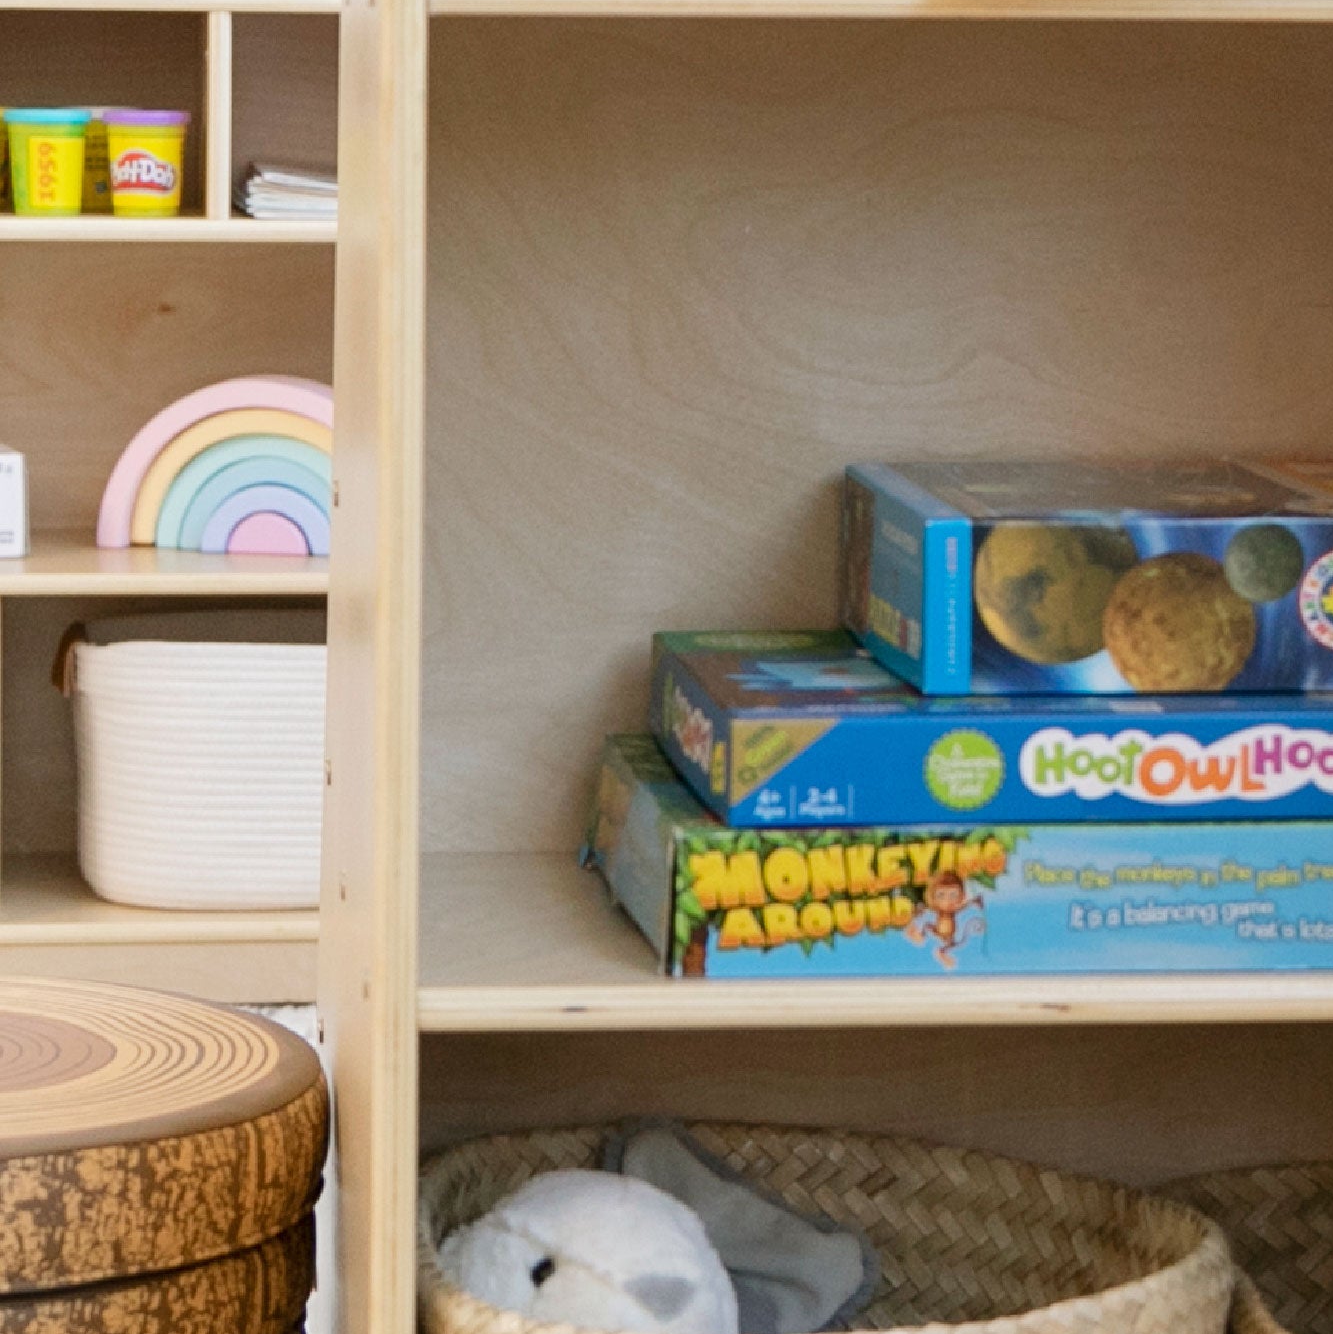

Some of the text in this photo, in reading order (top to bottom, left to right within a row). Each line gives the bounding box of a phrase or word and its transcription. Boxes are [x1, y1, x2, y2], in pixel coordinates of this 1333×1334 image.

[690, 837, 1006, 910] MONKEYING
[716, 896, 915, 951] AROUND
[1105, 907, 1121, 927] a
[1122, 898, 1218, 927] balancing
[1220, 901, 1275, 925] game
